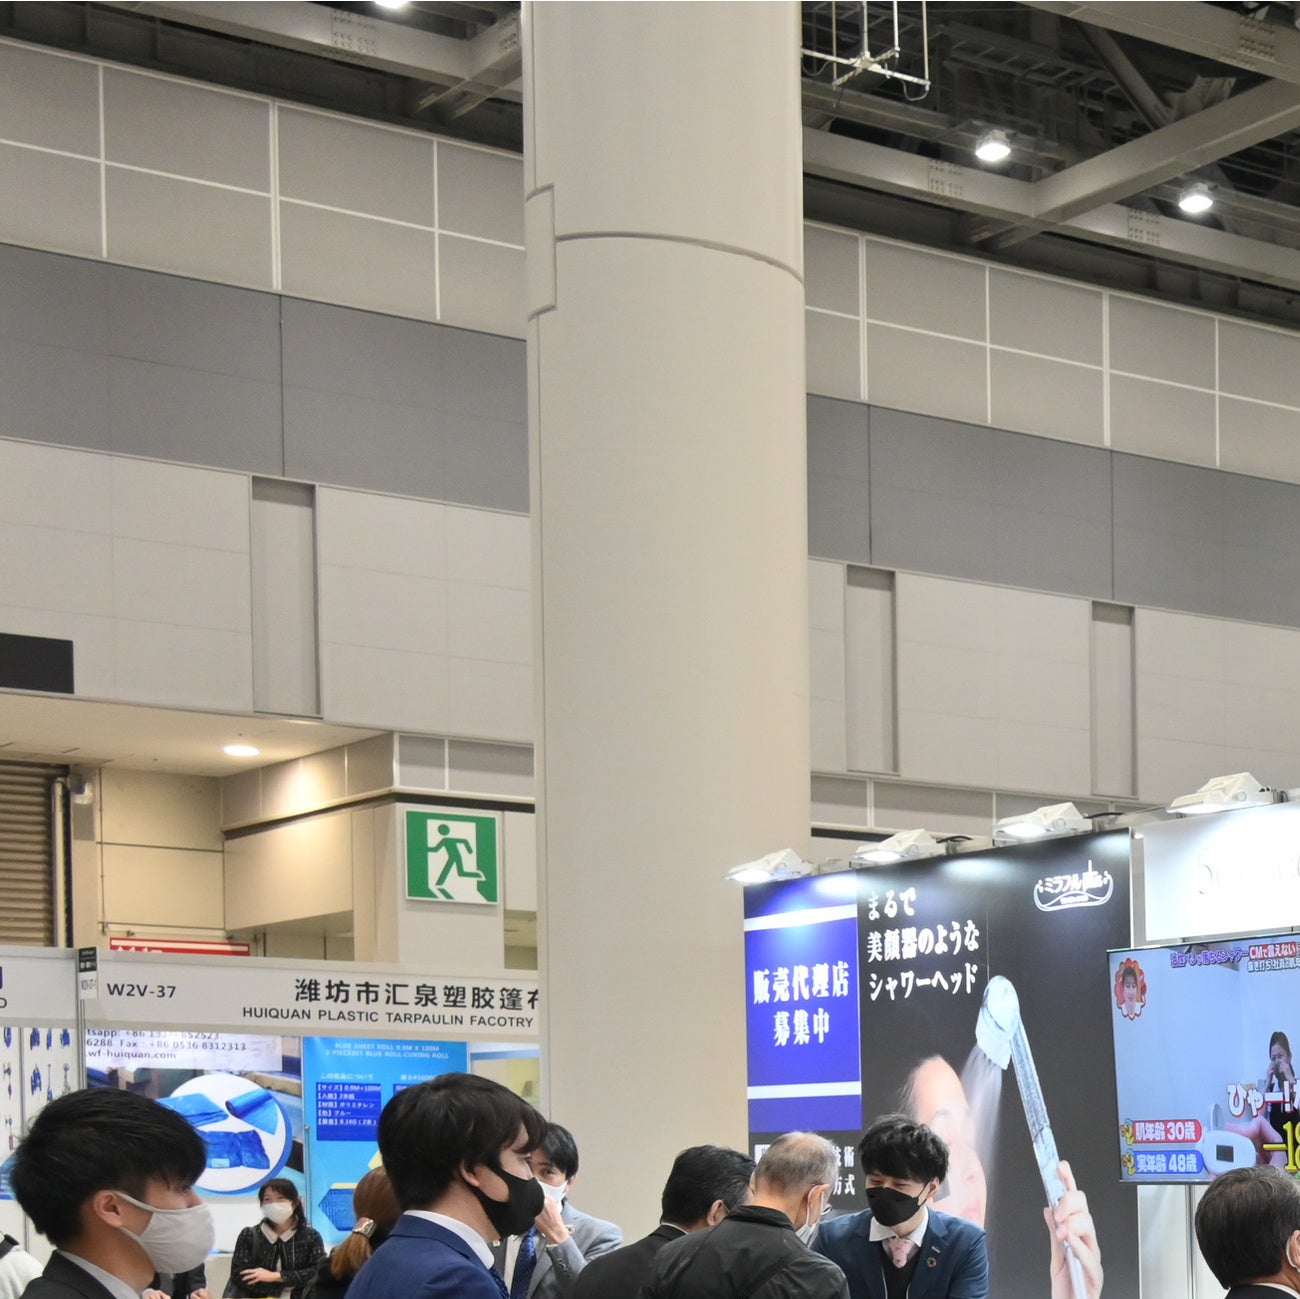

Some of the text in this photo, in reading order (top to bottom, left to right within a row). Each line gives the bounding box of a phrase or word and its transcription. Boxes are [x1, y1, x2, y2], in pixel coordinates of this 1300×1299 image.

[867, 887, 917, 921] まるで
[867, 919, 980, 963] 美顔器のような
[106, 982, 177, 999] W2V-37
[753, 960, 850, 1006] 販売代理店
[869, 961, 979, 1002] シャワーヘッド
[242, 1006, 534, 1028] HUIQUAN PLASTIC TARPAULIN FACOTRY
[773, 1007, 831, 1048] 募集中
[1168, 1152, 1198, 1173] 48歳
